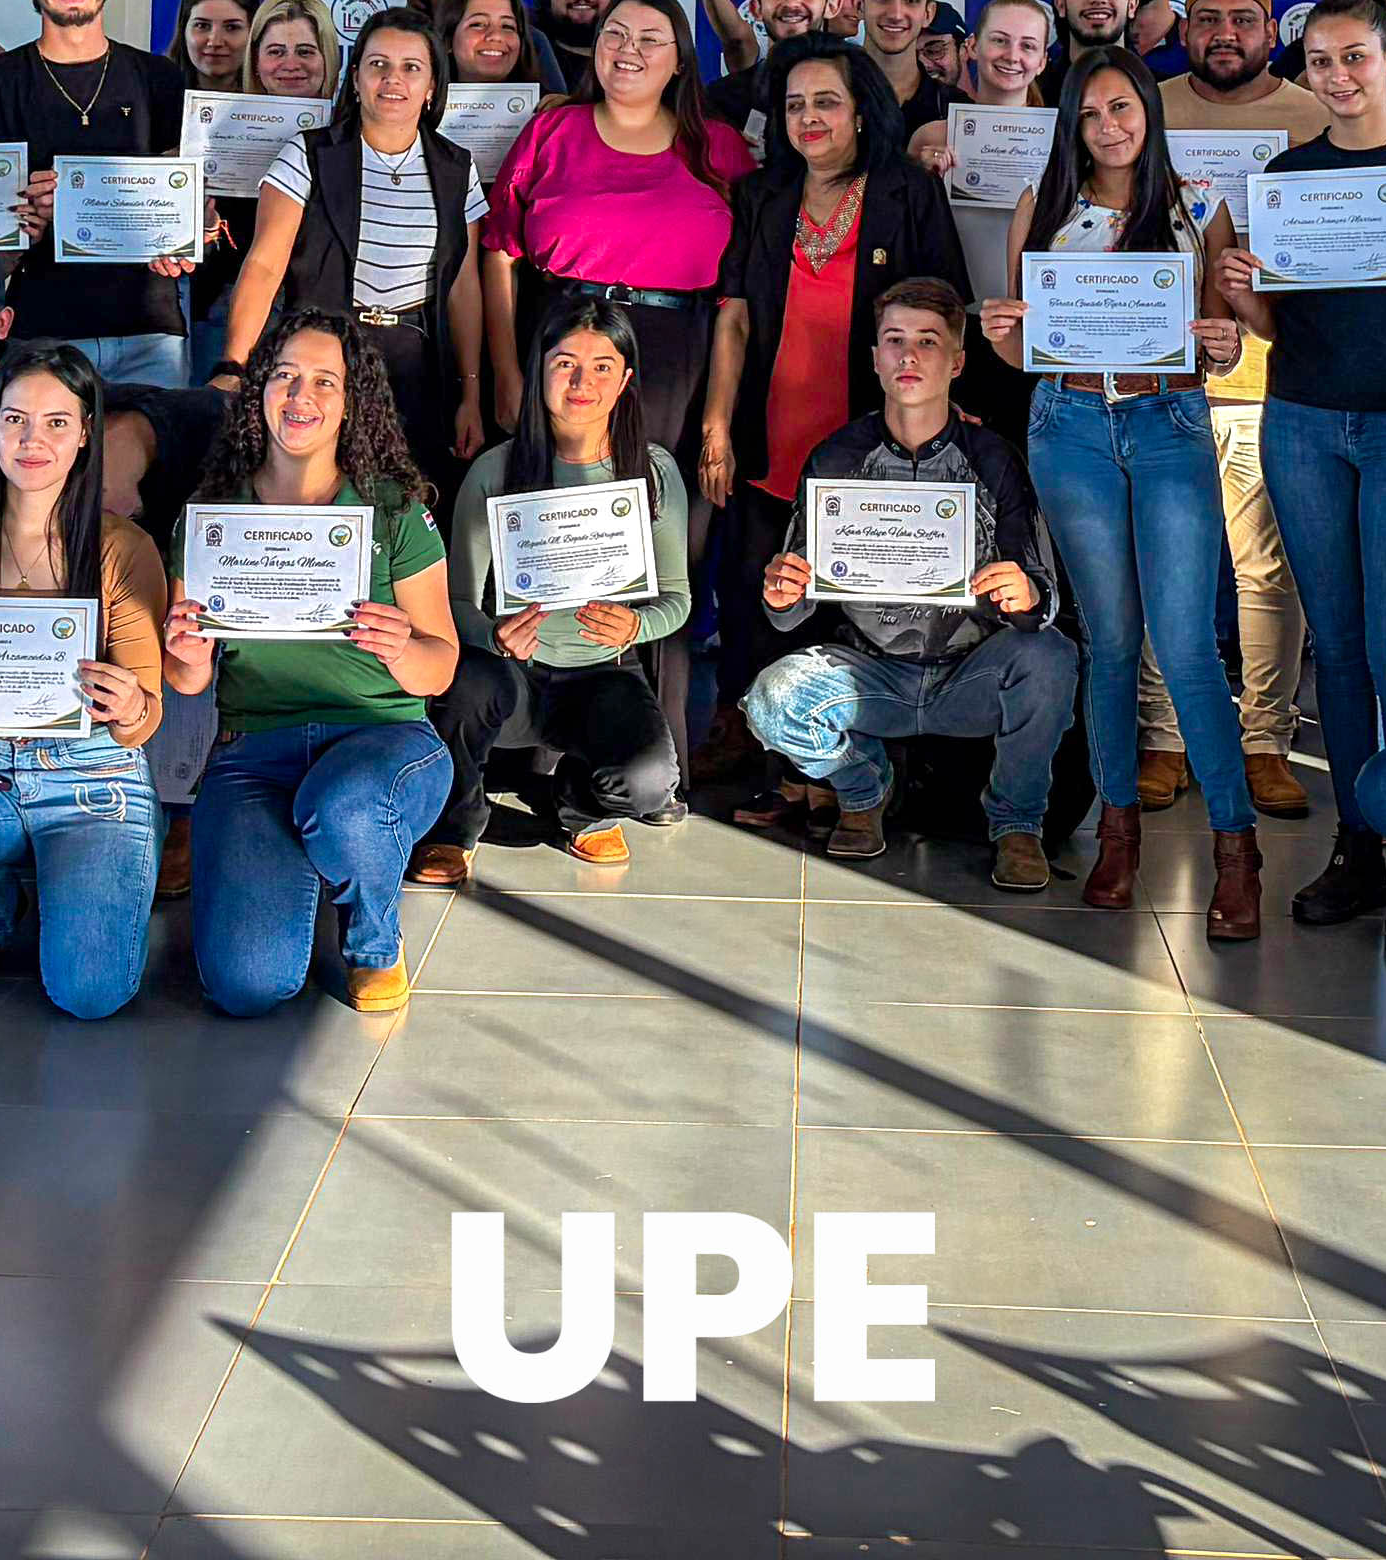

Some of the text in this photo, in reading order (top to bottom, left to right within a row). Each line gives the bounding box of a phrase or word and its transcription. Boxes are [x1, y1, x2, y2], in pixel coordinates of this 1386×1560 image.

[992, 125, 1046, 135] CERTIFICADO
[1185, 149, 1240, 157] CERTIFICADO
[101, 176, 156, 186] CERTIFICADO
[1300, 191, 1363, 202] CERTIFICADO
[1075, 274, 1139, 284] CERTIFICADO
[859, 502, 921, 514] CERTIFICADO
[538, 507, 598, 522] CERTIFICADO
[243, 530, 313, 542] CERTIFICADO
